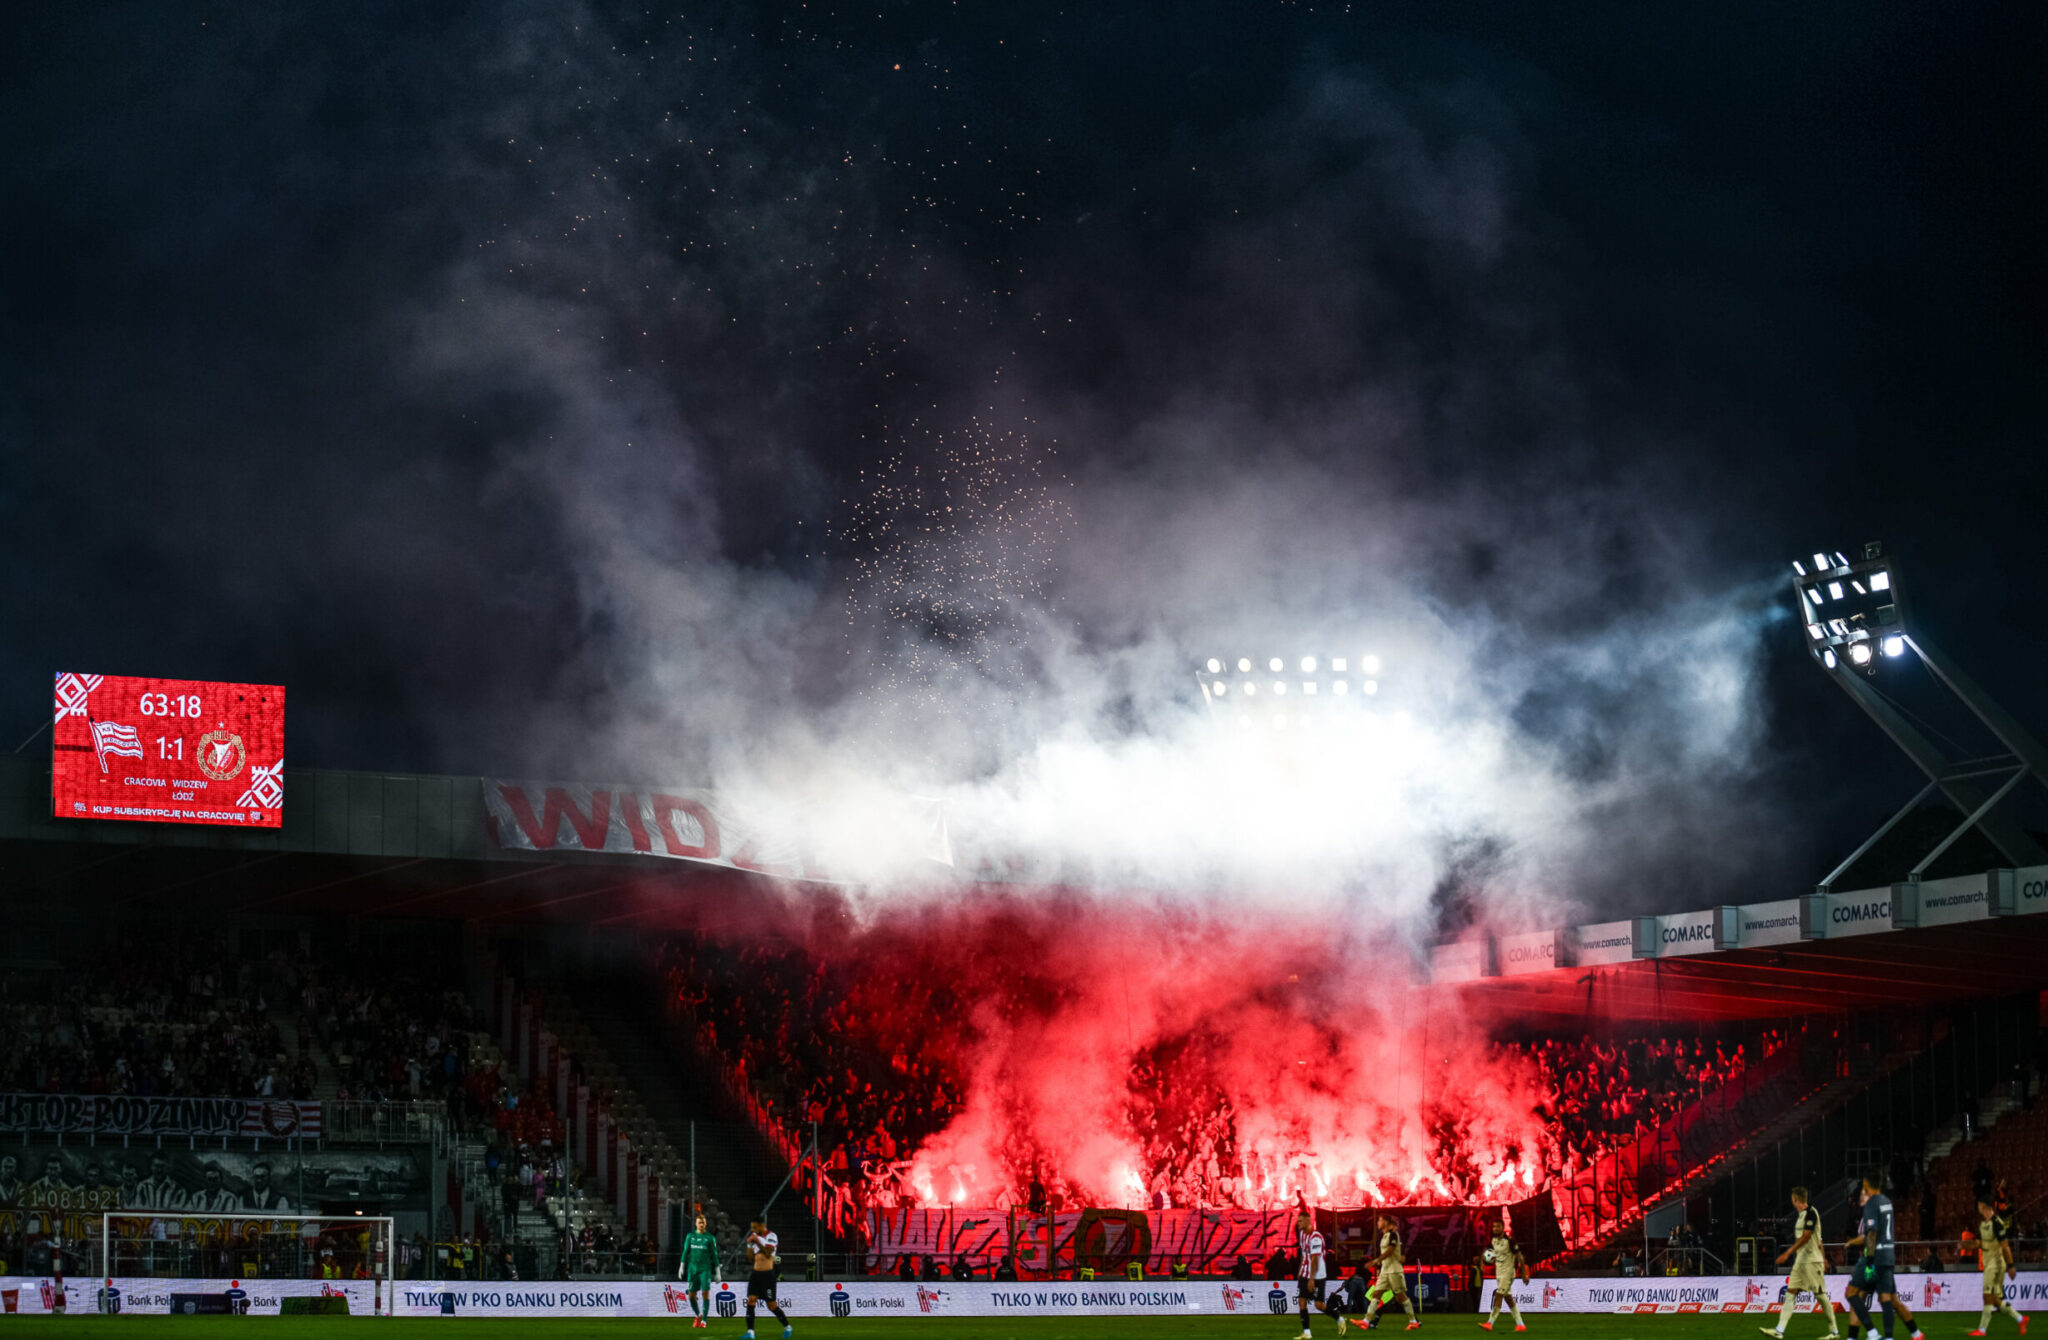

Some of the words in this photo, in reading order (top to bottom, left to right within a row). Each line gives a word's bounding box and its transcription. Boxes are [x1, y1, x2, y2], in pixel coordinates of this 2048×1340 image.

[140, 692, 201, 718] 63:18
[156, 736, 182, 760] 1:1
[124, 777, 166, 787] CRACOVIA
[172, 779, 208, 789] WIDZEW
[172, 790, 194, 801] ŁÓDŹ
[93, 805, 112, 814] KUP
[114, 807, 181, 819] SUBSKRYPCJĘ
[182, 811, 196, 819] NA
[197, 811, 245, 823] CRACOVIĘ!
[0, 1095, 84, 1129] KTOR
[94, 1097, 246, 1134] RODZINNY
[472, 1292, 501, 1307] PKO
[506, 1292, 555, 1307] BANKU
[560, 1292, 623, 1307] POLSKIM
[991, 1293, 1032, 1306] TYLKO
[1034, 1293, 1048, 1306] W
[1052, 1293, 1077, 1306] PKO
[1081, 1293, 1127, 1306] BANKU
[1129, 1292, 1186, 1306] POLSKIM
[1589, 1289, 1613, 1303] TYLKO
[1615, 1289, 1627, 1302] W
[1627, 1289, 1645, 1302] PKO
[1646, 1289, 1677, 1302] BANKU
[1679, 1288, 1719, 1302] POLSKIM
[2020, 1284, 2032, 1300] W
[128, 1295, 152, 1305] Bank
[155, 1295, 170, 1305] Pol
[253, 1297, 278, 1307] Bank
[856, 1298, 879, 1308] Bank
[880, 1298, 905, 1309] Polski
